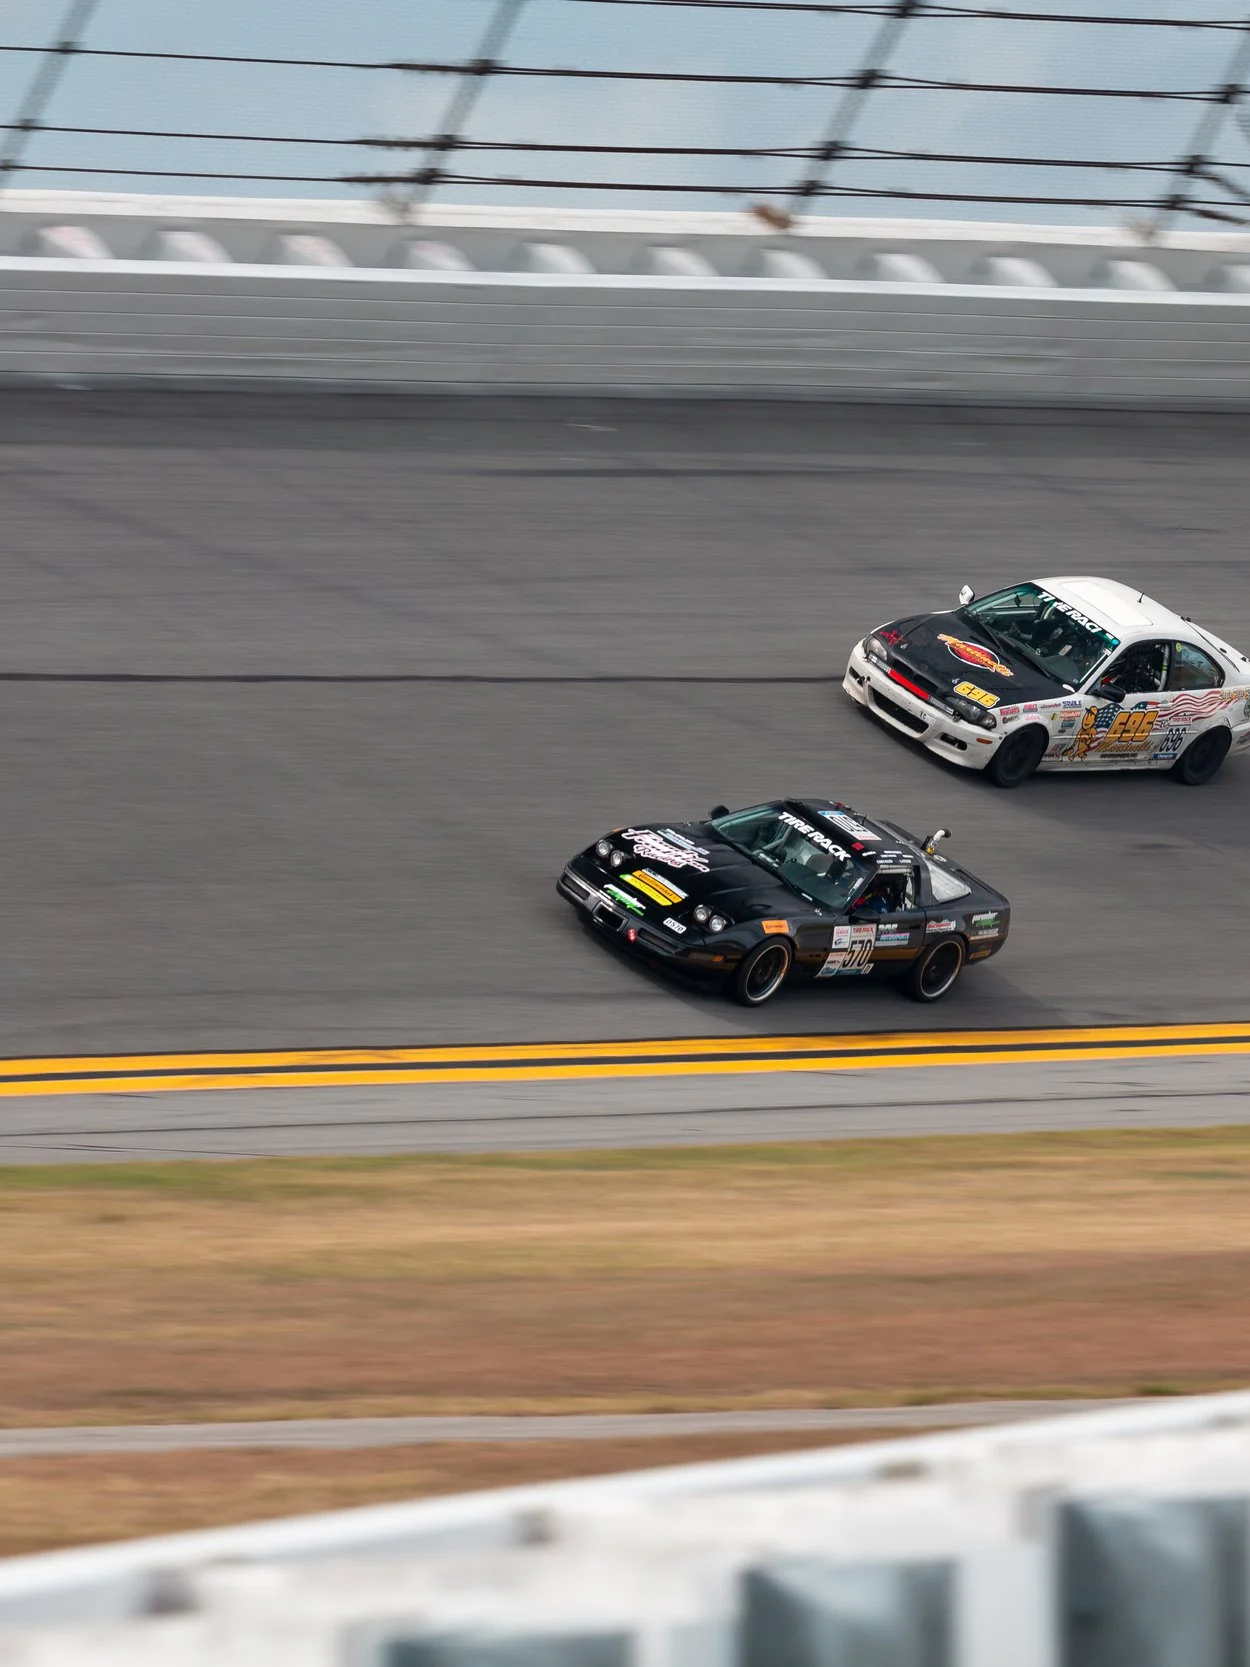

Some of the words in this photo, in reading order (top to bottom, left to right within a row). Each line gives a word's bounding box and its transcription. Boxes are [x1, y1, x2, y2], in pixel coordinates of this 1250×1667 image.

[953, 681, 1000, 708] 696
[1106, 710, 1159, 742] 696
[1159, 727, 1186, 752] 696
[842, 939, 873, 968] 570
